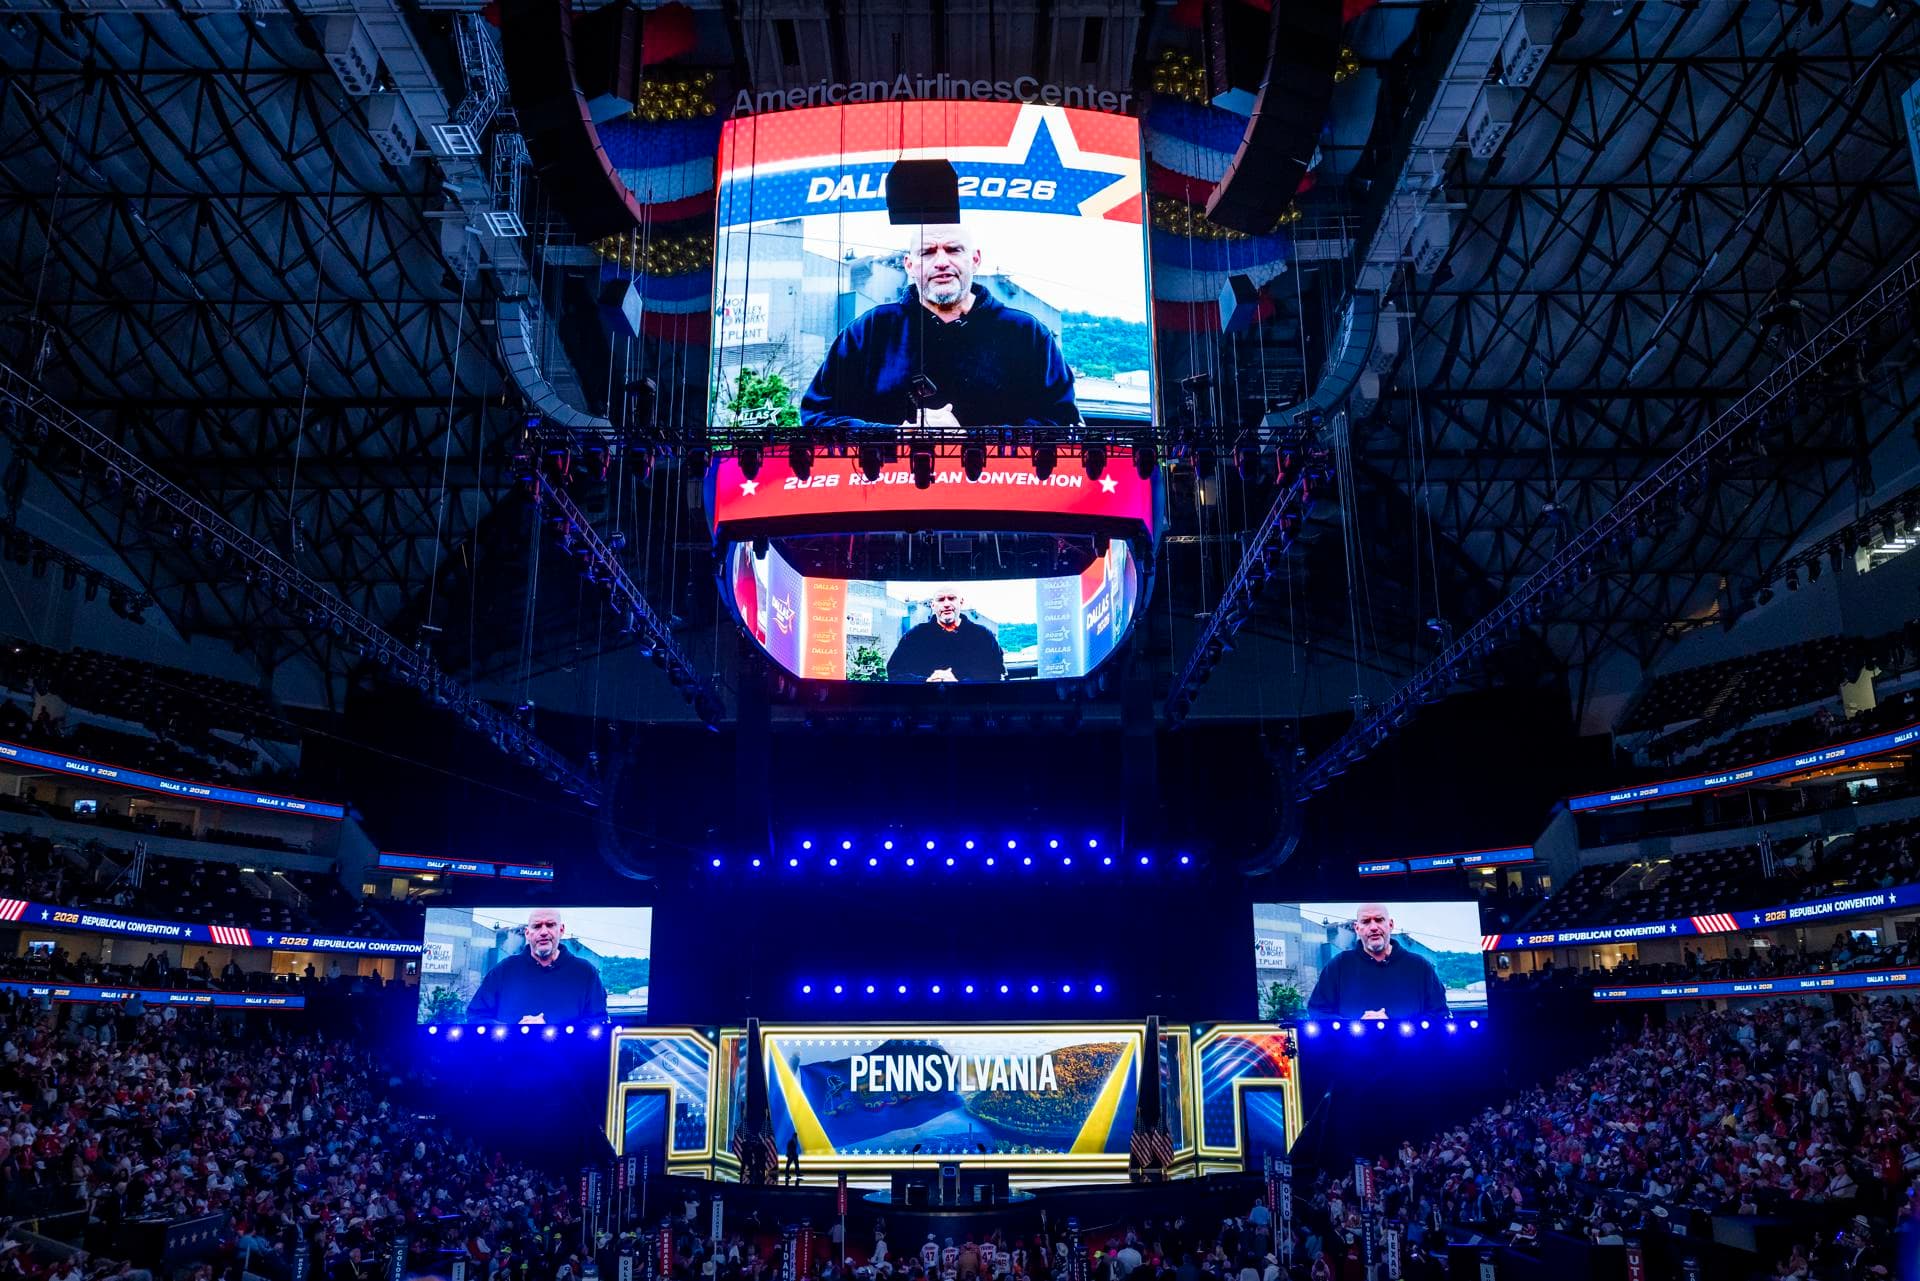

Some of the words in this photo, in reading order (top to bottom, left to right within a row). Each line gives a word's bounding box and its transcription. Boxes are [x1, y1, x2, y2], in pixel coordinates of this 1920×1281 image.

[806, 173, 888, 203] DALL
[957, 176, 1057, 201] 2026
[783, 474, 839, 491] 2026
[1044, 646, 1072, 654] DALLAS
[1895, 733, 1912, 743] DALLAS
[1796, 756, 1816, 765] DALLAS
[1826, 750, 1845, 758] 2026
[66, 762, 88, 771] DALLAS
[98, 769, 117, 777] 2026
[1705, 777, 1726, 785] DALLAS
[1736, 771, 1753, 779] 2026
[160, 782, 180, 790] DALLAS
[1766, 911, 1786, 921] 2026
[1790, 903, 1832, 918] REPUBLICAN
[1835, 895, 1883, 911] CONVENTION
[53, 912, 79, 923] 2026
[82, 916, 126, 929] REPUBLICAN
[127, 922, 179, 935] CONVENTION
[1529, 935, 1554, 943] 2026
[1559, 930, 1611, 941] REPUBLICAN
[1614, 925, 1665, 937] CONVENTION
[280, 937, 308, 945] 2026
[313, 939, 366, 949] REPUBLICAN
[369, 943, 422, 952] CONVENTION
[850, 1055, 1058, 1093] PENNSYLVANIA
[1365, 1222, 1373, 1264] MINNESOTA
[782, 1242, 791, 1281] IDAH
[925, 1251, 935, 1261] 47
[1629, 1256, 1640, 1281] UT
